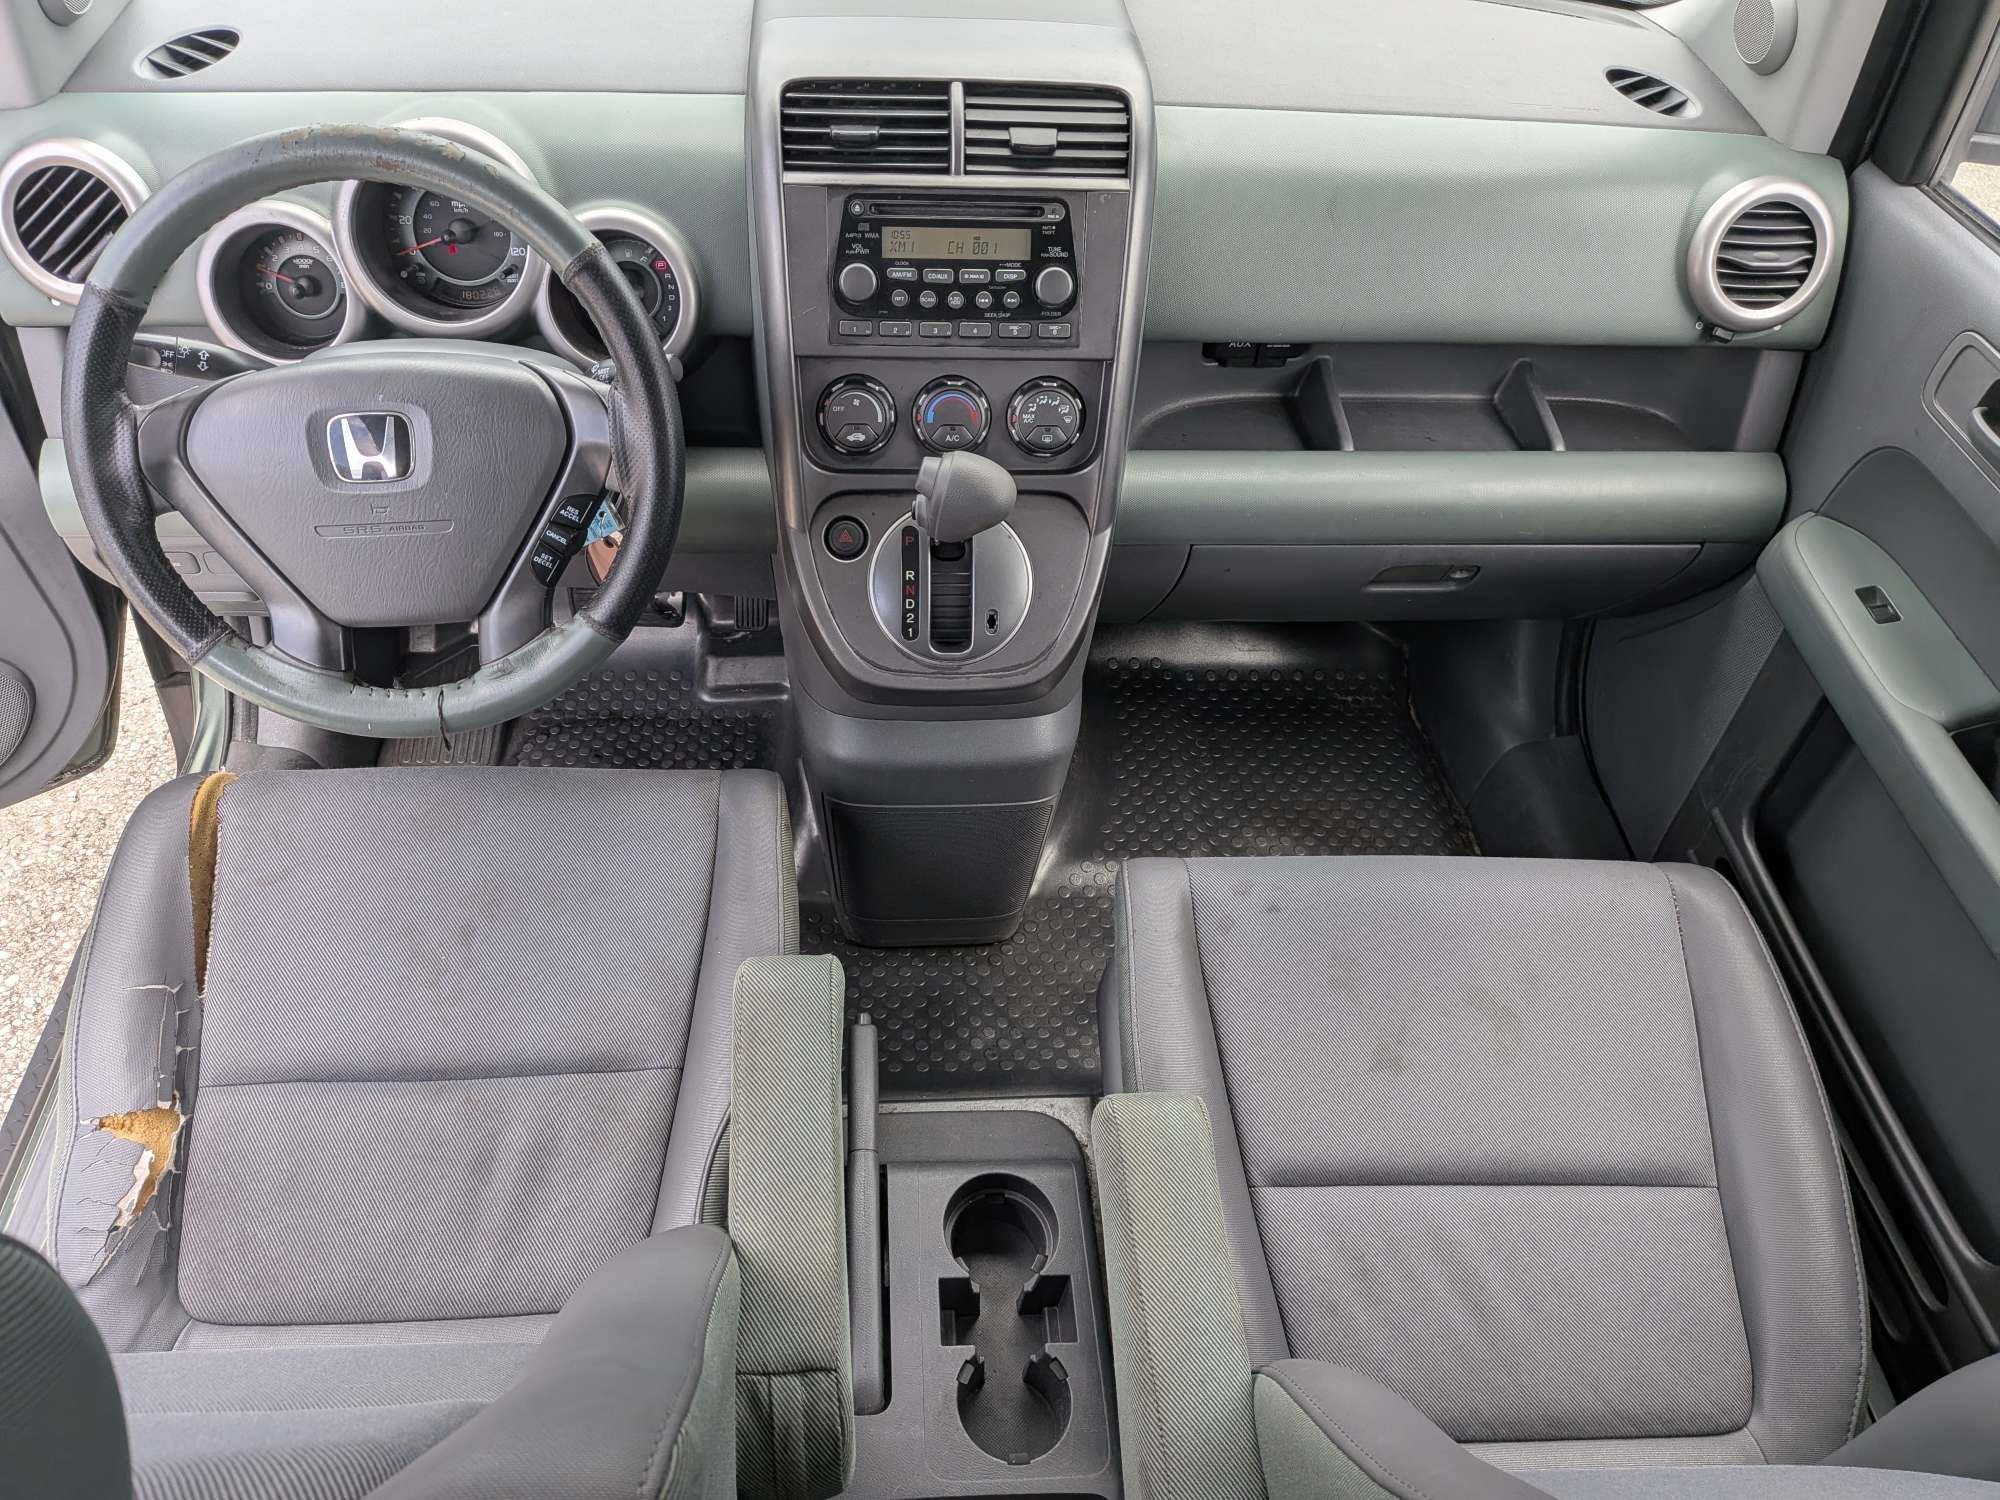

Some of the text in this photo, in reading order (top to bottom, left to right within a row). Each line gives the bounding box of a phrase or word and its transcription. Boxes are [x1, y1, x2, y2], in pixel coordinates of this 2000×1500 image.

[399, 215, 412, 225] 20
[510, 247, 526, 257] 120
[945, 433, 960, 442] A/C
[560, 509, 580, 522] ACCEL
[546, 529, 567, 545] CANCEL
[533, 556, 553, 569] DECEL
[905, 570, 915, 580] R
[905, 584, 915, 595] N
[905, 599, 915, 609] D
[906, 613, 915, 623] 2
